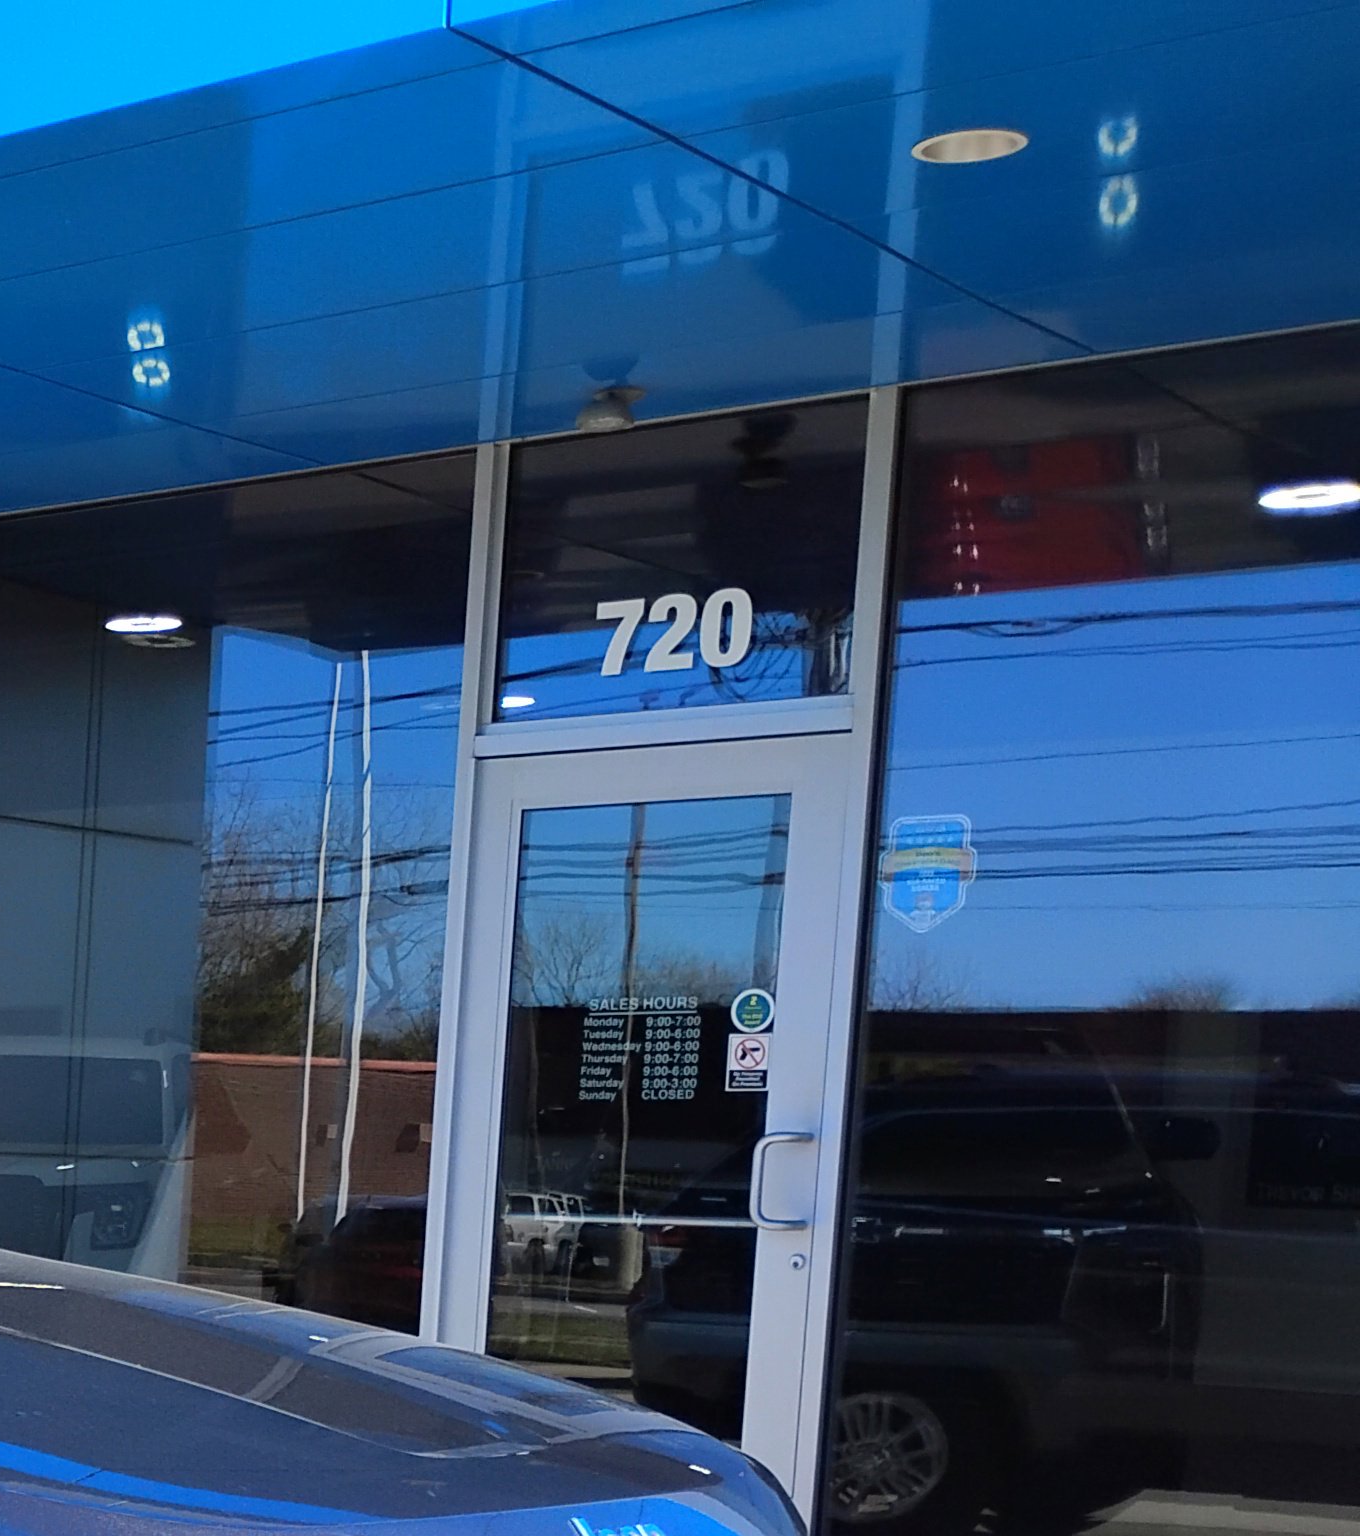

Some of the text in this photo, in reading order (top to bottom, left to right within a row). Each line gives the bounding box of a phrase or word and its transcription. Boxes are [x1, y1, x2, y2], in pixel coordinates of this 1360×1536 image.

[595, 587, 753, 676] 720
[588, 996, 698, 1012] SALES HOURS
[583, 1016, 701, 1028] Monday 9:00-7:00
[583, 1029, 624, 1040] Tuesday
[582, 1042, 641, 1052] Wednesday
[581, 1053, 699, 1065] Thursday 9:00-7:00
[580, 1066, 612, 1077] Friday
[579, 1078, 697, 1089] Saturday 9:00-3:00
[579, 1089, 694, 1102] Sunday CLOSED
